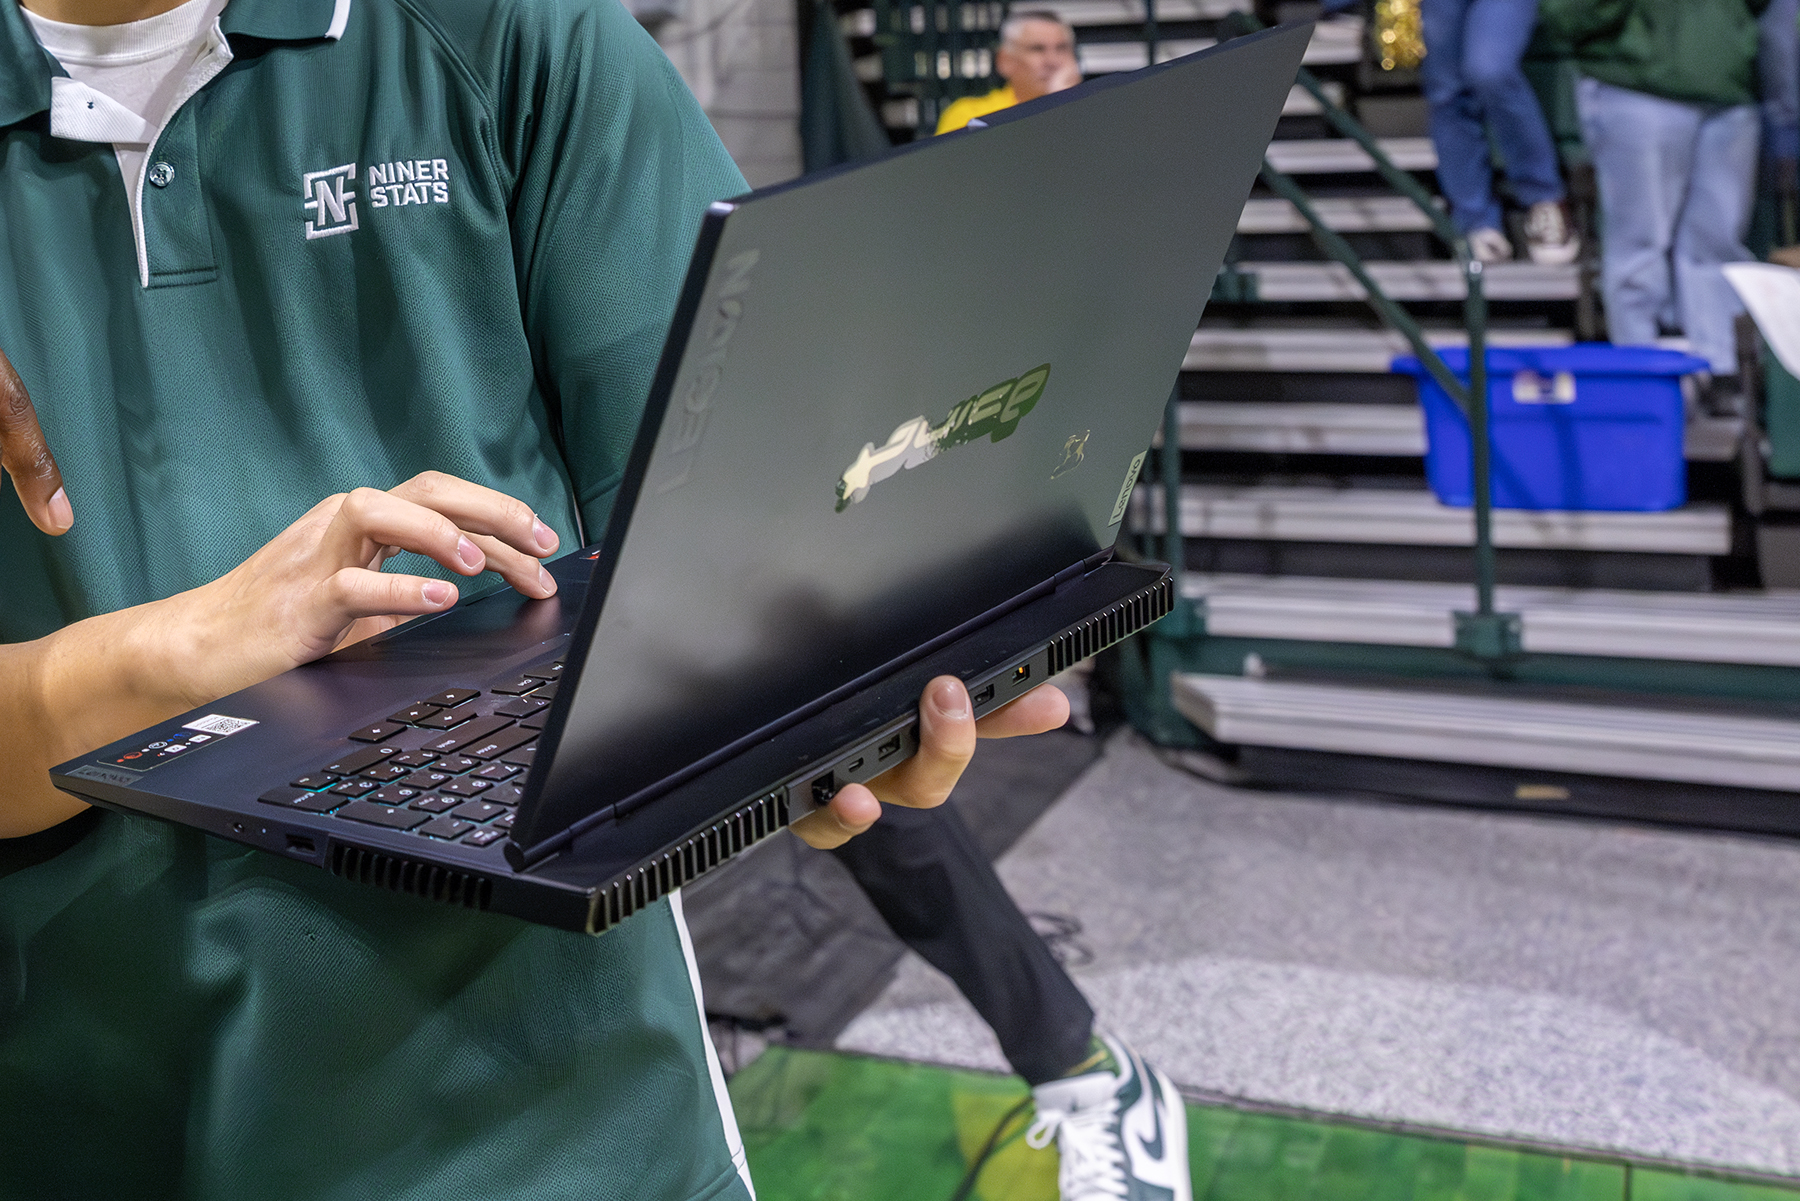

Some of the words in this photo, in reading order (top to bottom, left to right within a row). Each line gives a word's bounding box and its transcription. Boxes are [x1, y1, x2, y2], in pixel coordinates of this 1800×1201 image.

[368, 158, 449, 186] NINER
[370, 181, 449, 208] STATS
[1112, 458, 1141, 519] Lenovo
